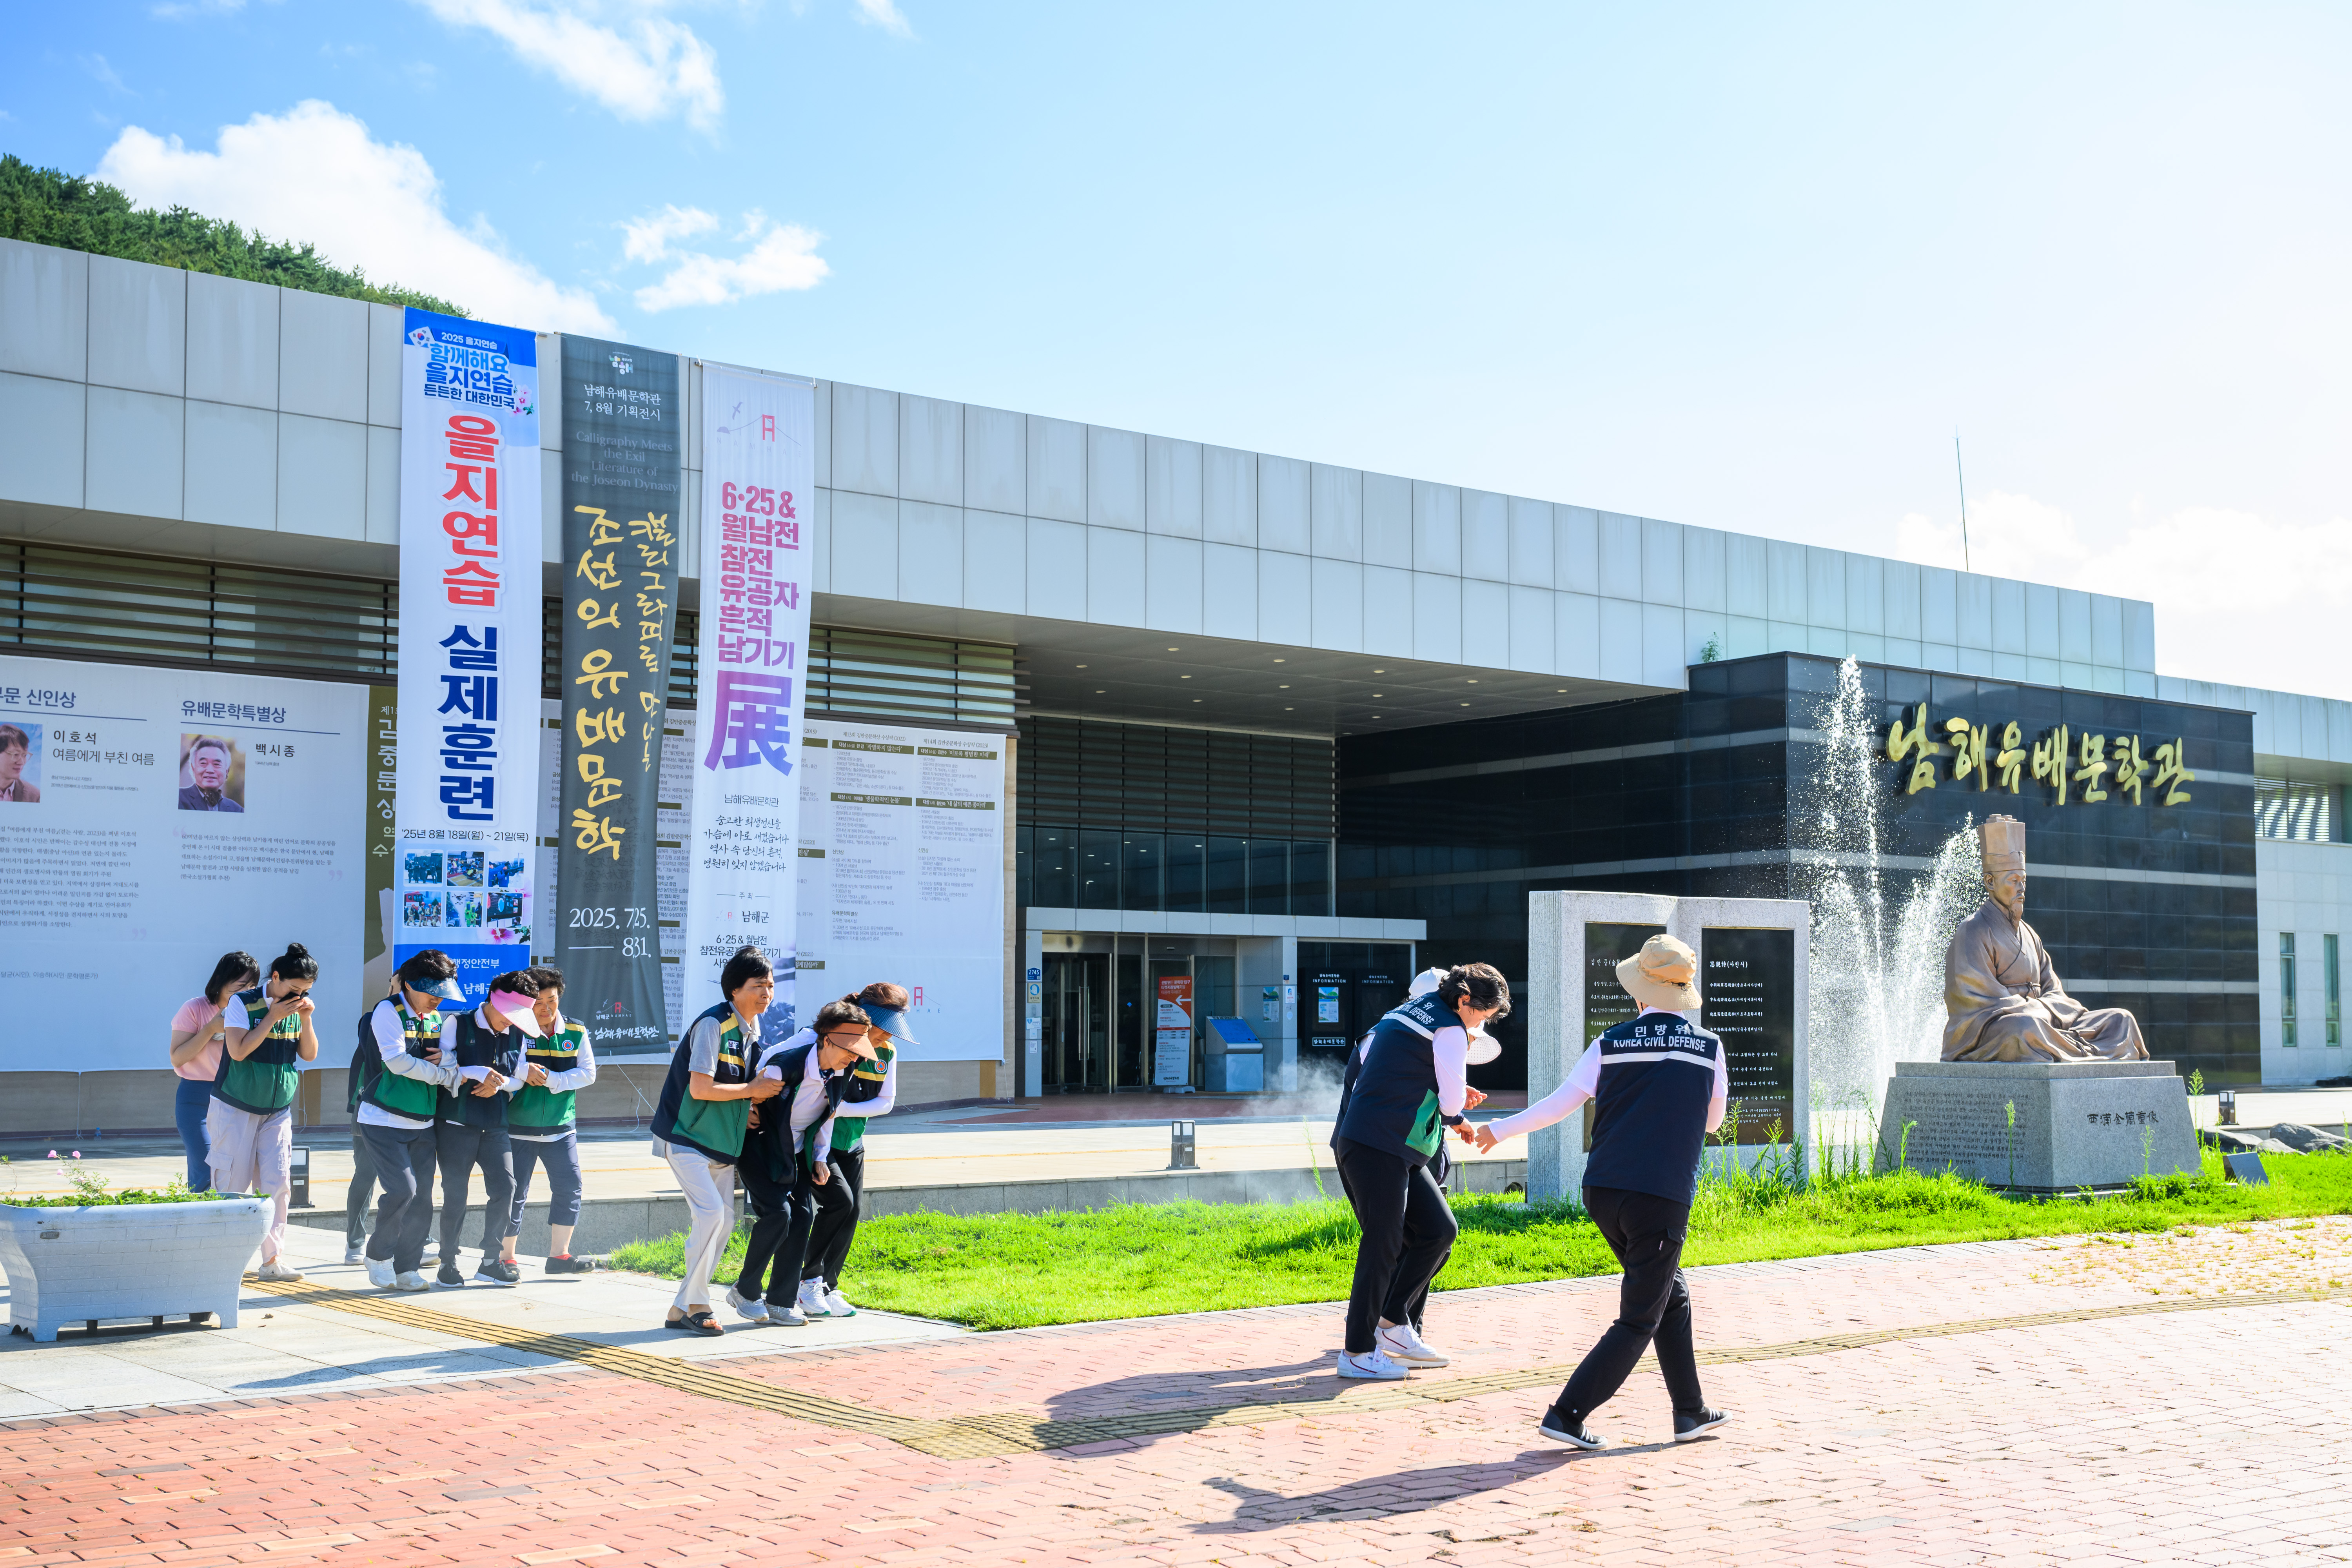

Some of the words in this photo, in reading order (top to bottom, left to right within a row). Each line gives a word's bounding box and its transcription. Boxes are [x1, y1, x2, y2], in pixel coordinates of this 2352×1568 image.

[441, 332, 464, 343] 2025
[465, 337, 497, 350] 을지연습
[430, 343, 508, 374] 함께해요
[426, 361, 513, 395] 을지연습
[424, 383, 462, 400] 든든한
[465, 388, 515, 410] 대한민국
[584, 384, 661, 405] 남해유배문학관
[596, 402, 613, 416] 8월
[617, 405, 661, 421] 기획전시
[576, 431, 638, 453] Calligraphy
[642, 439, 672, 452] Meets
[604, 448, 622, 459] the
[625, 452, 645, 462] Exil
[591, 460, 643, 476] Literature
[646, 466, 658, 477] of
[571, 472, 589, 483] the
[591, 475, 631, 488] Joseon
[635, 479, 678, 494] Dynasty
[442, 415, 500, 607] 을지연습
[721, 513, 799, 551] 월남전
[574, 506, 624, 629] 조선의
[720, 544, 773, 577] 참전
[720, 575, 799, 610] 유공자
[719, 604, 772, 636] 흔적
[718, 635, 795, 670] 남기기
[0, 687, 20, 704] 문
[27, 690, 76, 708] 신인상
[181, 701, 286, 723] 유배문학특별상
[437, 625, 498, 820] 실제훈련
[704, 670, 793, 776] 展
[54, 730, 96, 744] 이호석
[53, 748, 100, 762] 여름에게
[104, 751, 127, 764] 부친
[132, 753, 155, 766] 여름
[256, 744, 295, 757] 백시종
[572, 649, 628, 861] 유배문학
[1886, 702, 2195, 807] 남해유배문학관
[725, 794, 779, 808] 남해유배문학관
[716, 815, 743, 826] 숭고한
[745, 817, 781, 829] 희생정신을
[402, 829, 426, 839] '25년
[429, 830, 445, 839] 8월
[448, 830, 484, 840] 18일(월)
[494, 831, 528, 842] 21일(목)
[703, 829, 731, 840] 가슴에
[734, 831, 752, 841] 아로
[710, 844, 729, 855] 역사
[731, 845, 740, 855] 속
[743, 846, 764, 857] 당신의
[767, 847, 782, 859] 흔적,
[704, 858, 729, 869] 영원히
[732, 859, 747, 870] 잊지
[750, 860, 786, 873] 않겠습니다
[569, 907, 620, 929] 2025.
[742, 911, 769, 923] 남해군
[746, 935, 767, 945] 월남전
[1410, 1007, 1434, 1025] DEFENSE
[595, 1025, 659, 1040] 남해유배문학관
[1613, 1037, 1642, 1047] KOREA
[1644, 1036, 1666, 1047] CIVIL
[1668, 1036, 1706, 1052] DEFENSE
